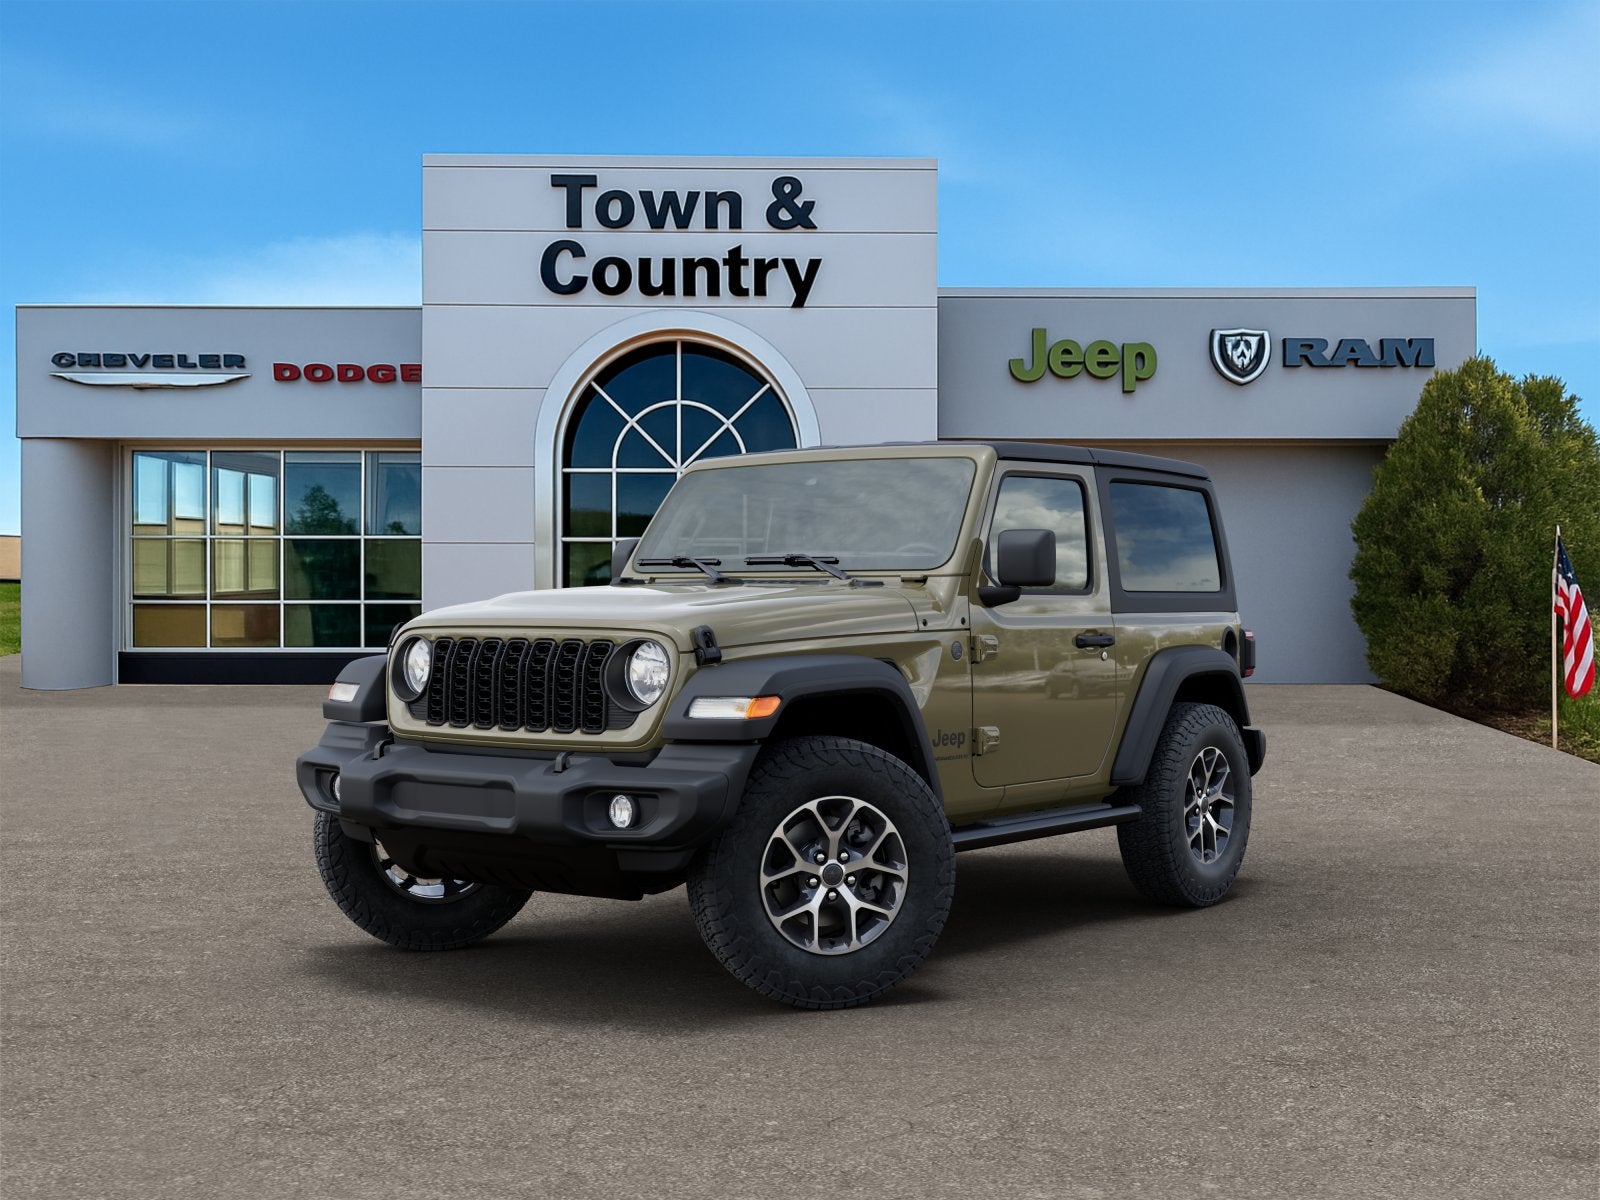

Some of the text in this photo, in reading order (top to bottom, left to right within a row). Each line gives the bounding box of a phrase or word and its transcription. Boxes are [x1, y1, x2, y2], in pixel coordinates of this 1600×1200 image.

[550, 174, 818, 230] Town &
[540, 239, 822, 308] Country
[273, 363, 422, 383] DODGE
[1009, 328, 1157, 393] Jeep
[1282, 337, 1435, 367] RAM
[932, 728, 965, 749] Jeep
